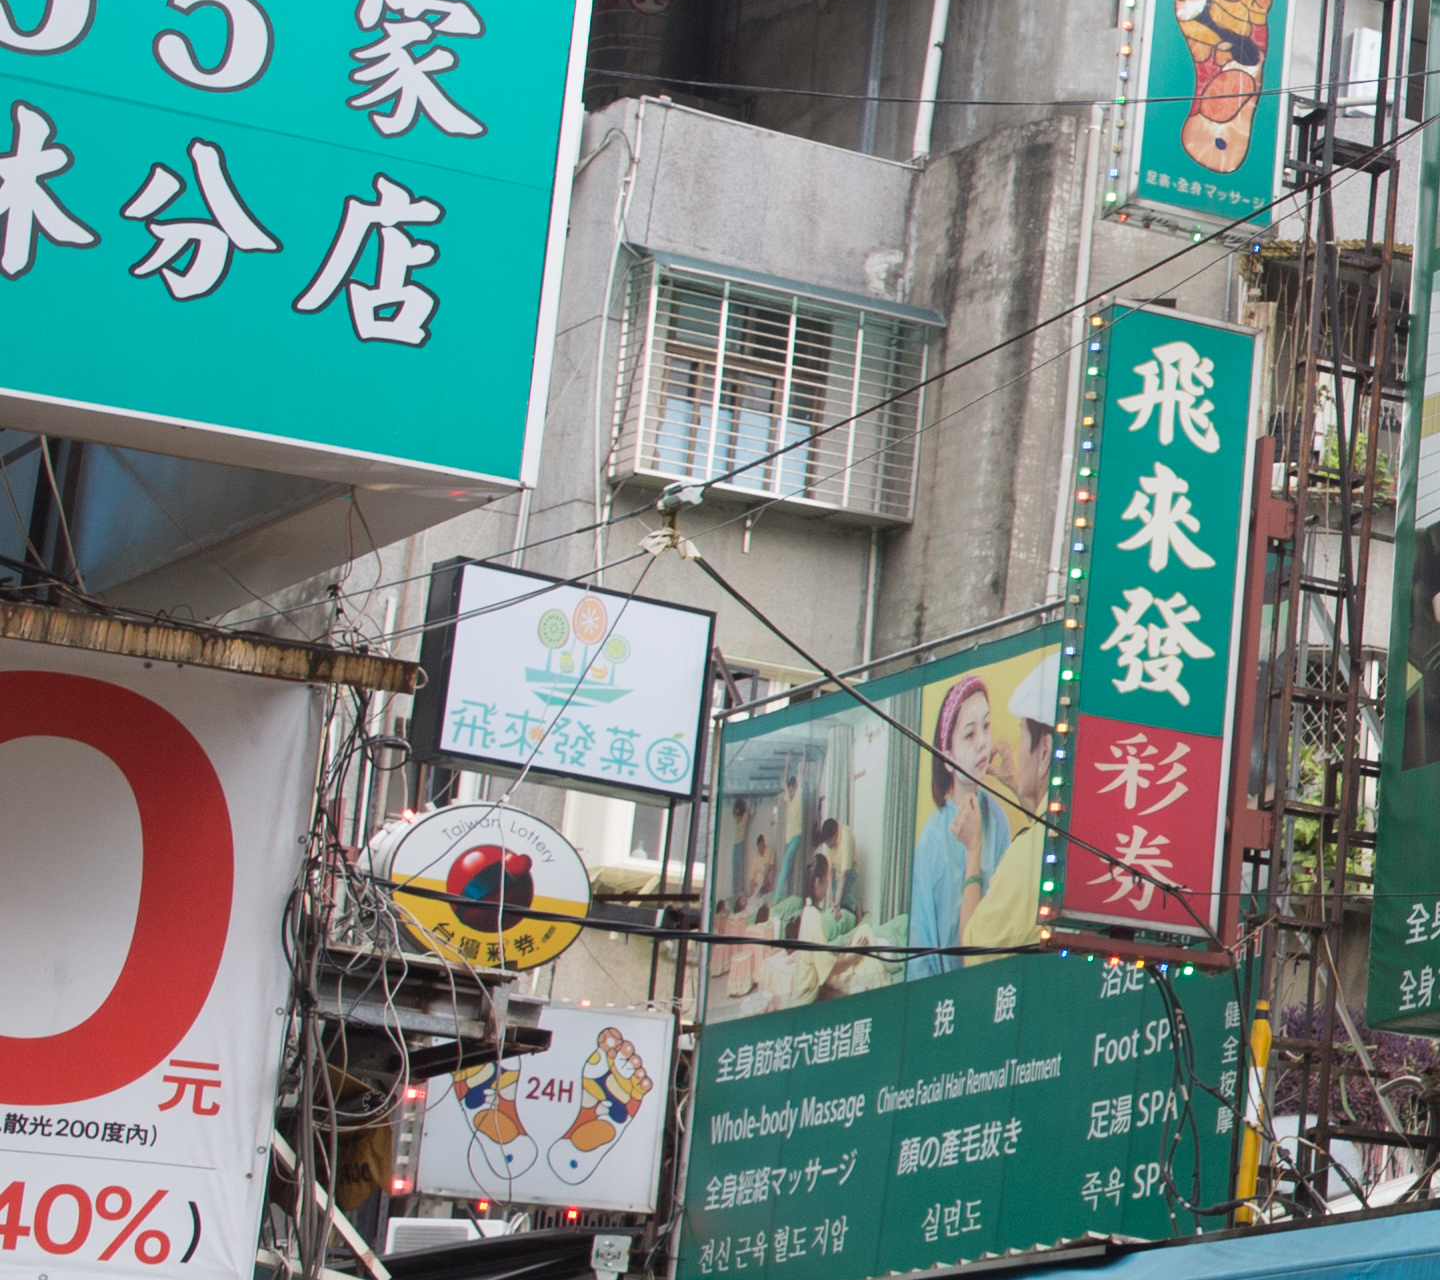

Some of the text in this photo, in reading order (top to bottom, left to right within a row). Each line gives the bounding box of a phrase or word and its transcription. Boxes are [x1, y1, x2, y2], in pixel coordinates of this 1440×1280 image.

[1086, 340, 1222, 912] 飛來發 彩券
[450, 698, 690, 783] 飛來發菓園
[526, 1074, 574, 1105] 24H
[877, 1052, 1062, 1115] Chinese Facial Removal Treatment
[711, 1091, 866, 1145] Whole-body Massage
[735, 1223, 807, 1268] 근육 혈도
[921, 1198, 982, 1243] 실면도
